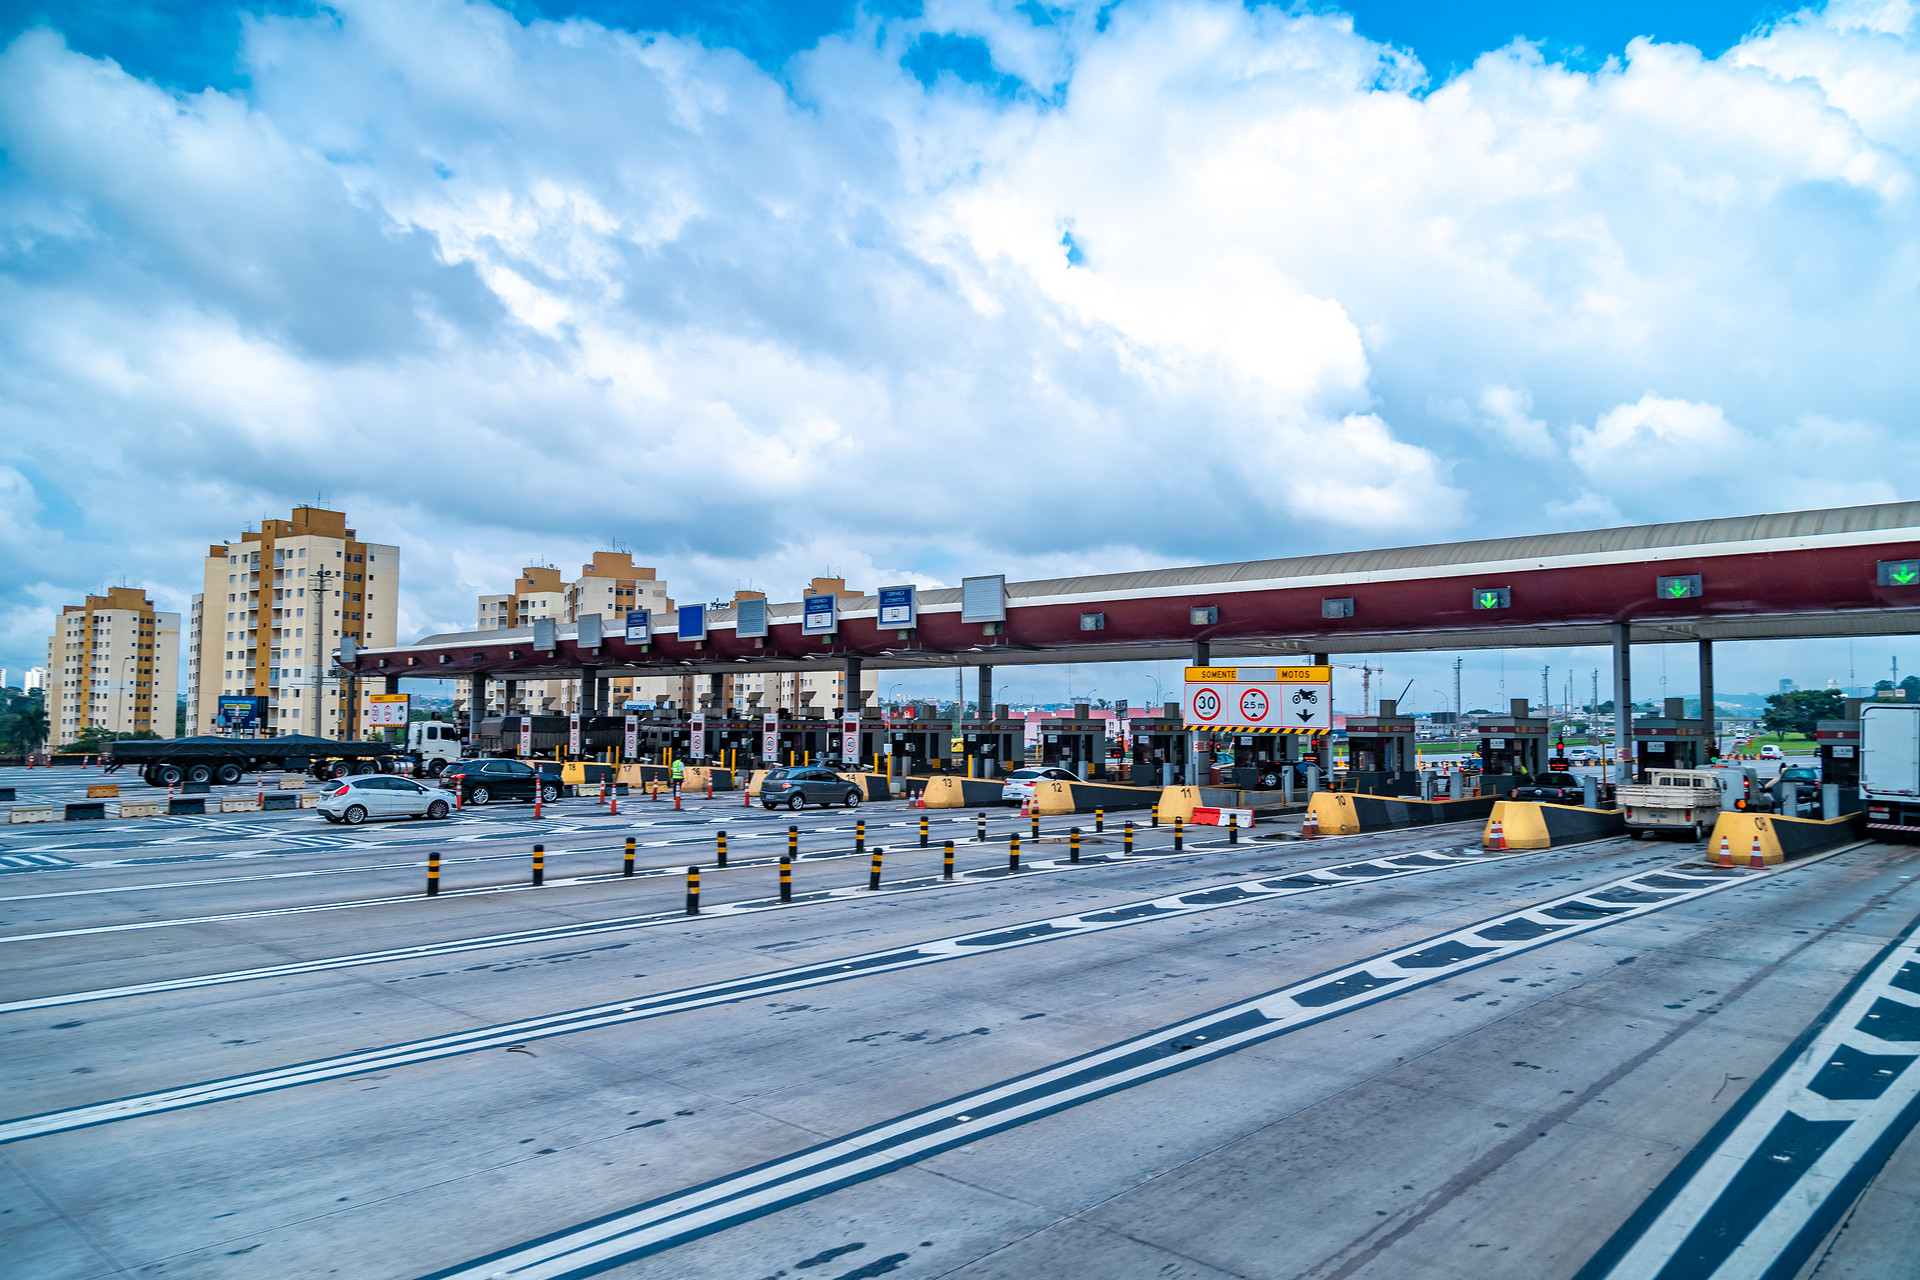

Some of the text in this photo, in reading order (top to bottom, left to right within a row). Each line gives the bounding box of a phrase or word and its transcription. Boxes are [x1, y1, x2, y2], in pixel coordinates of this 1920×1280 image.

[1201, 670, 1310, 679] SOMENTE MOTOS
[1198, 696, 1216, 710] 30
[568, 763, 576, 771] 18
[623, 765, 632, 773] 17
[692, 767, 700, 776] 16
[846, 774, 856, 783] 14
[942, 778, 952, 788] 13
[1051, 782, 1063, 792] 12
[1180, 788, 1192, 798] 11
[1335, 795, 1346, 806] 10
